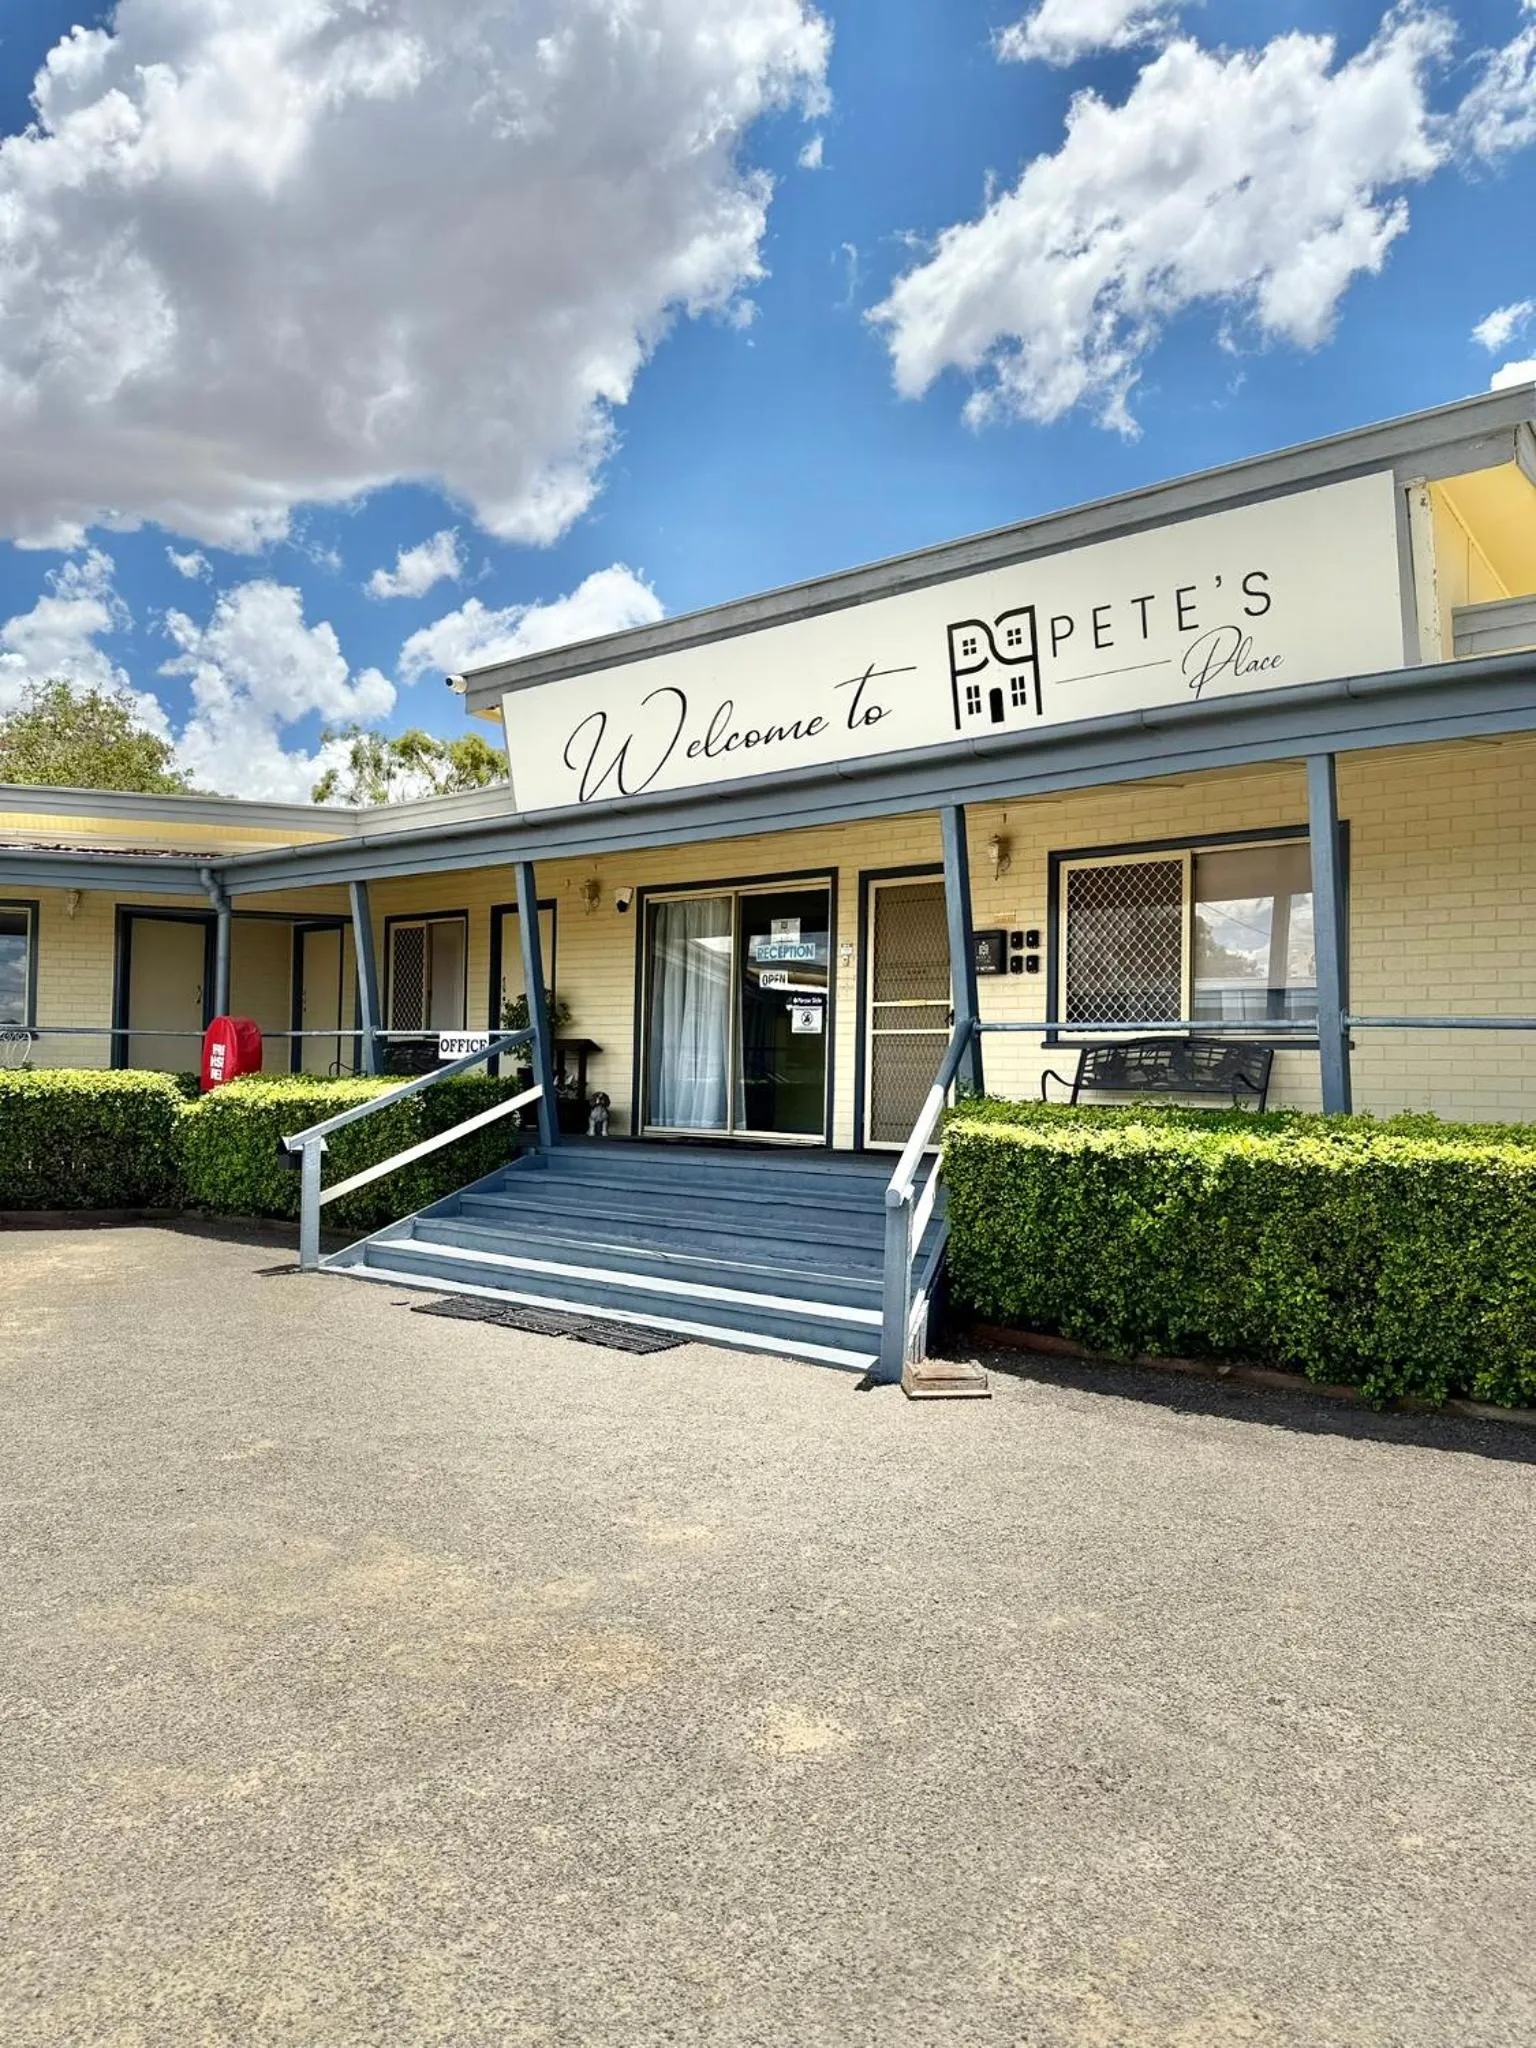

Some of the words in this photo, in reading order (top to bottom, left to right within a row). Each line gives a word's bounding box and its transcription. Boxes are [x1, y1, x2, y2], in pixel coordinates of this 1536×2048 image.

[1050, 571, 1272, 658] PETE'S
[1180, 624, 1284, 700] Place
[563, 686, 829, 803] Welcome
[834, 662, 917, 730] to
[757, 945, 815, 960] RECEPTION
[762, 973, 786, 986] OPEN
[440, 1038, 487, 1053] OFFICE
